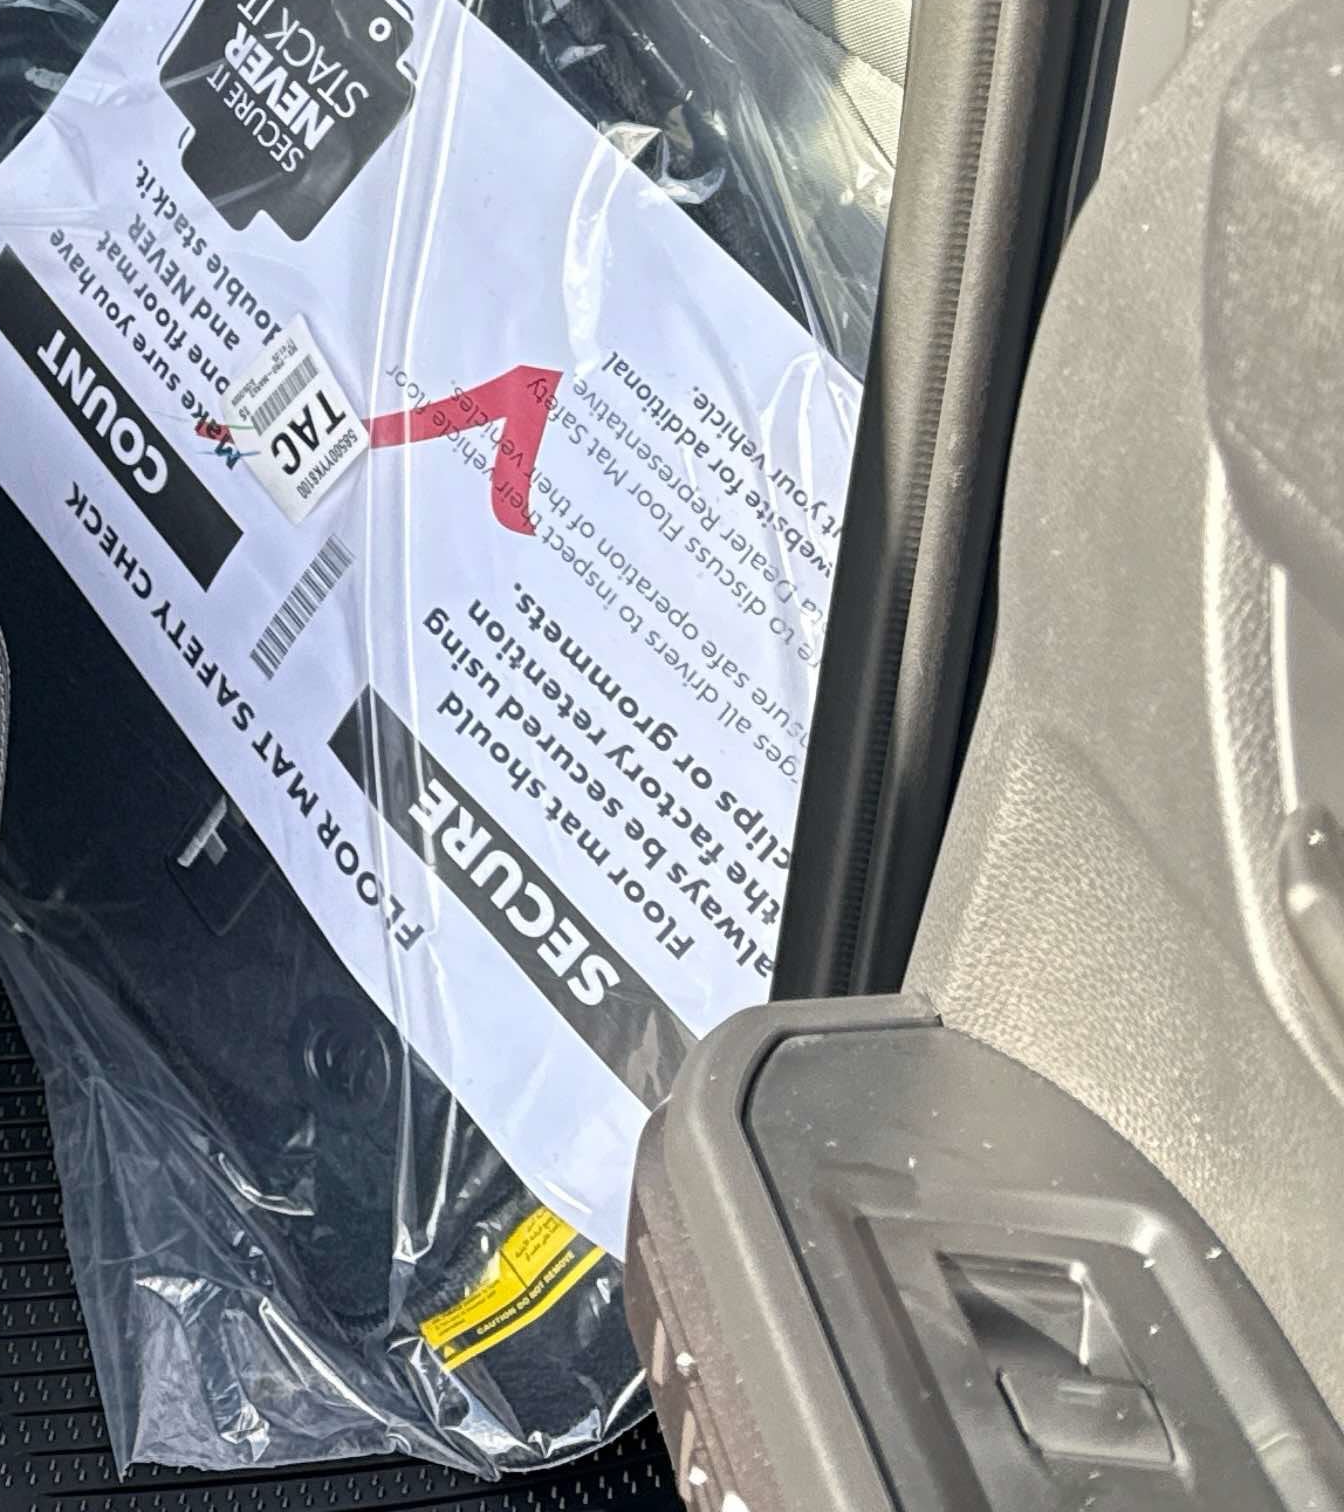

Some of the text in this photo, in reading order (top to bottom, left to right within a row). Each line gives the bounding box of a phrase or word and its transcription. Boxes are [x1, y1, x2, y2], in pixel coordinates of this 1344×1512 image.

[224, 22, 335, 151] NEVER
[263, 7, 370, 118] STACK
[206, 63, 305, 172] SECURE IT
[135, 159, 156, 197] it.
[96, 230, 139, 285] mat
[151, 186, 208, 257] stack
[127, 213, 241, 351] and NEVER
[133, 283, 188, 351] floor
[50, 229, 244, 471] Make sure you have
[383, 361, 432, 418] floor
[36, 329, 168, 494] COUNT
[270, 390, 347, 476] TAC
[423, 407, 501, 488] vehicle
[520, 373, 591, 446] Safety
[693, 386, 766, 471] vehicle.
[485, 472, 544, 533] their
[587, 437, 629, 487] Mat
[601, 351, 834, 584] website for additional
[766, 465, 827, 522] your
[626, 482, 685, 543] Floor
[440, 377, 811, 752] nsure safe operation of their vehicles.
[541, 525, 618, 610] inspect
[684, 536, 767, 616] discuss
[715, 523, 799, 605] Dealer
[618, 605, 644, 634] to
[644, 630, 719, 704] drivers
[65, 481, 427, 953] FLOOR MAT SAFETY CHECK
[513, 582, 791, 879] clips or grommets.
[717, 701, 753, 734] all
[422, 607, 774, 984] always be secured using
[468, 599, 781, 925] the factory retention
[436, 690, 695, 961] Floor mat should
[407, 778, 621, 1006] SECURE
[475, 1249, 575, 1336] CAUTION DO NOT REMOVE
